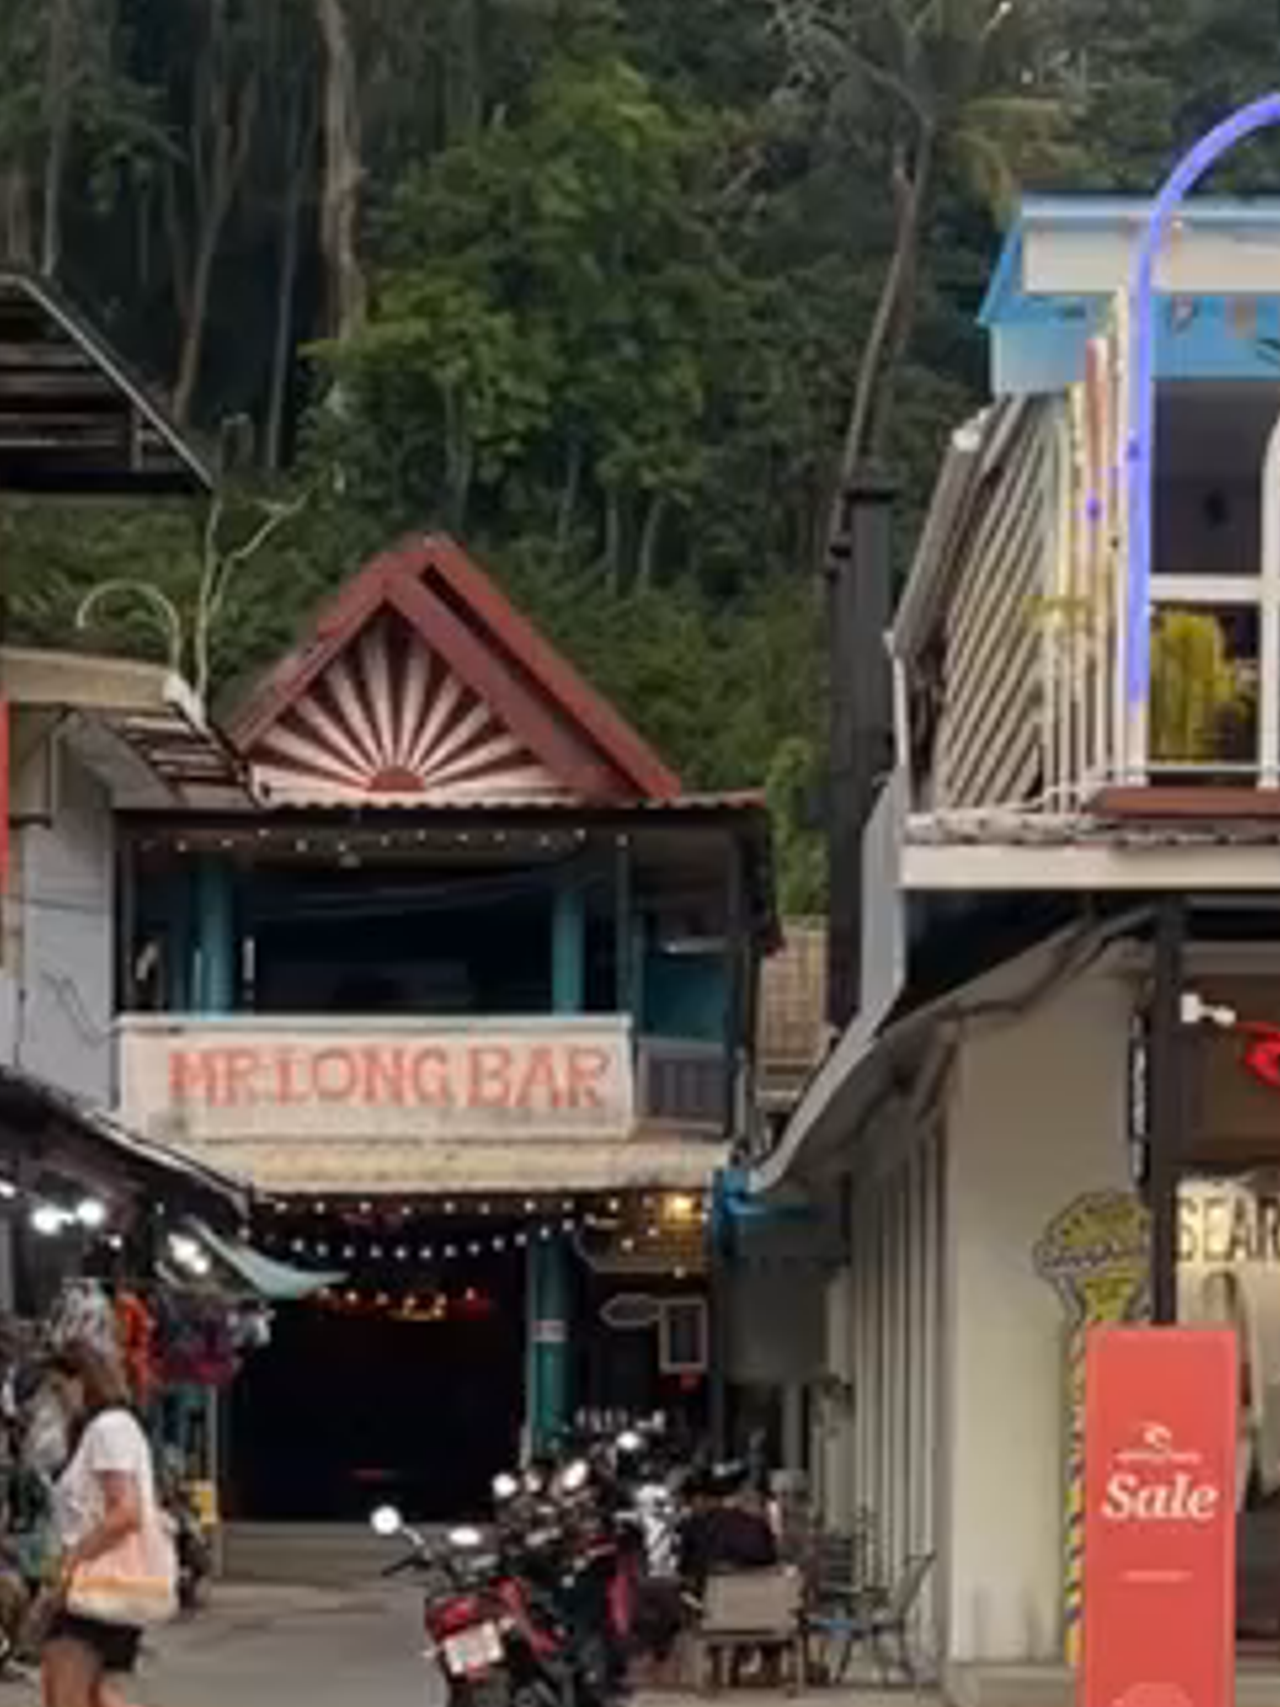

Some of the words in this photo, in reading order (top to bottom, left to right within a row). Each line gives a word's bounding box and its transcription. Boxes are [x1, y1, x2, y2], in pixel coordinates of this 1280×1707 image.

[275, 1044, 451, 1109] LONG
[466, 1044, 610, 1109] BAR
[1101, 1470, 1219, 1523] Sale
